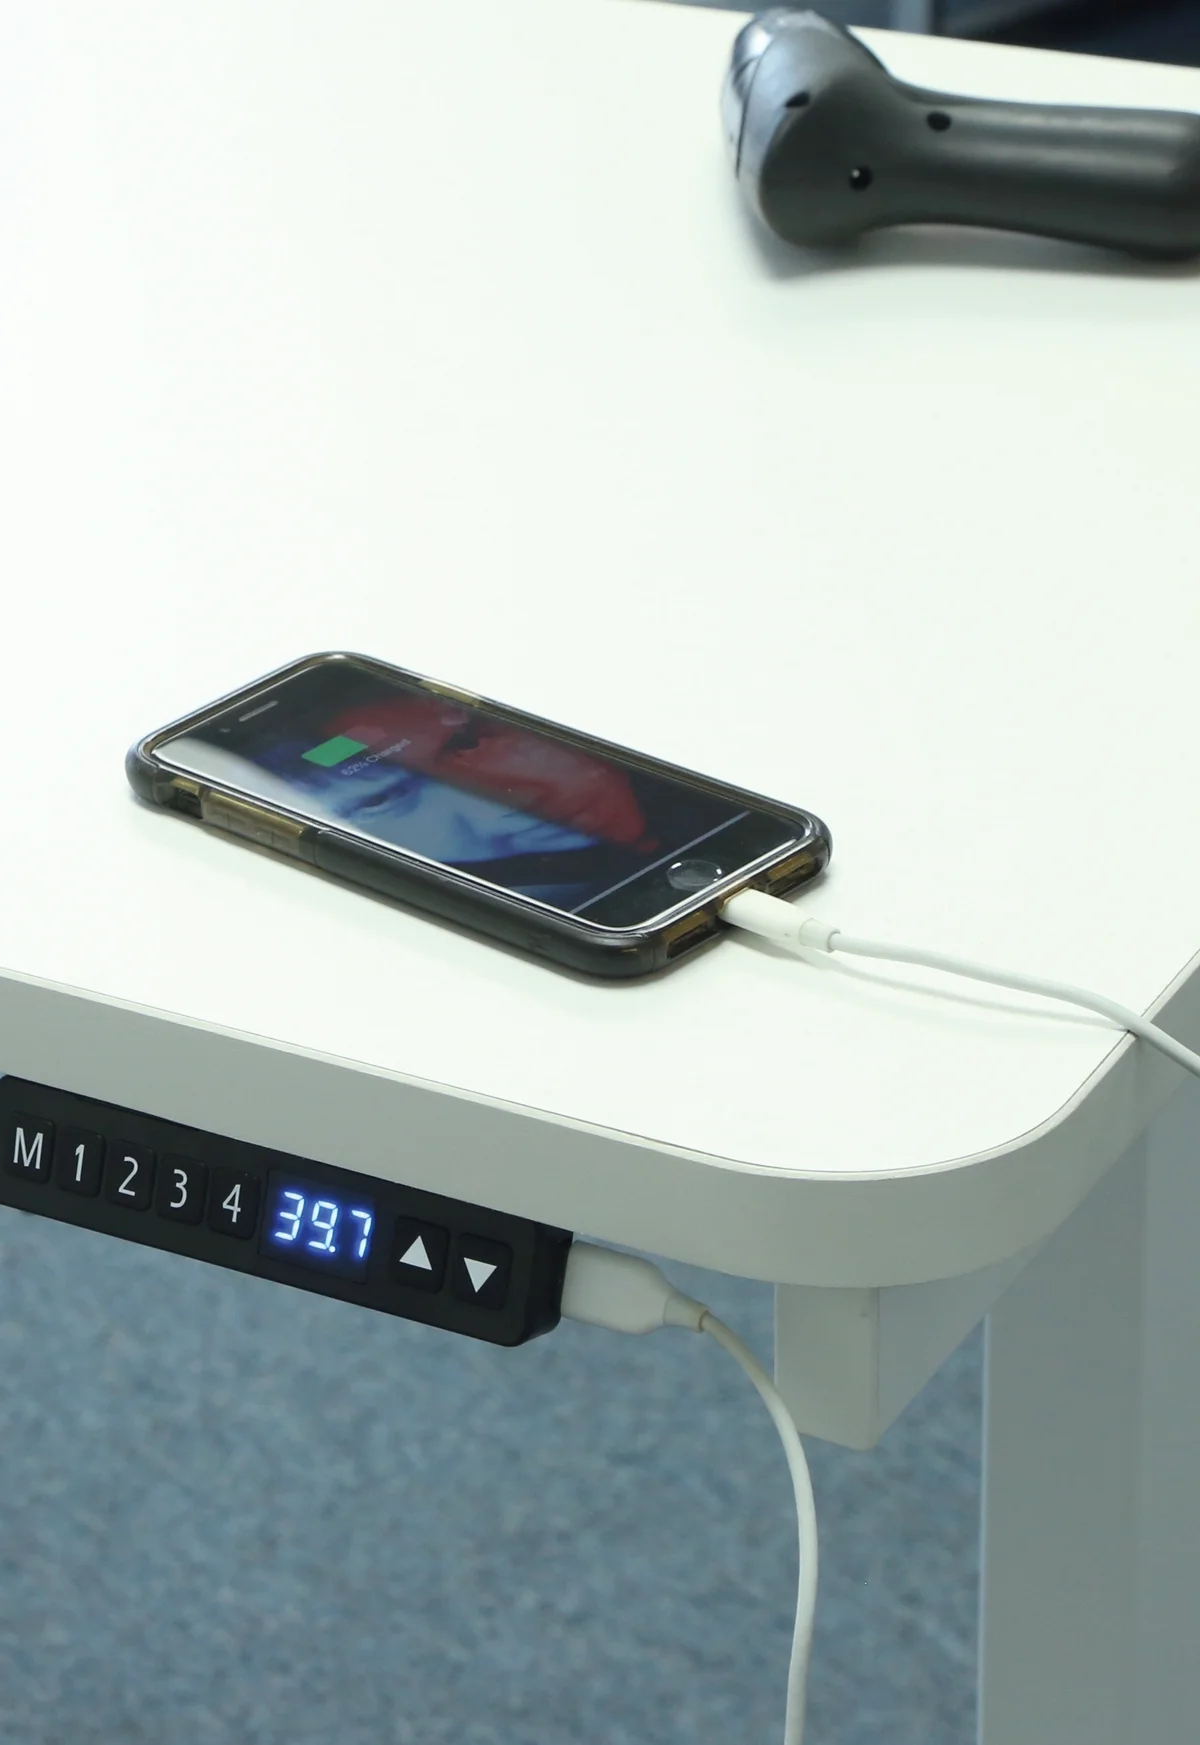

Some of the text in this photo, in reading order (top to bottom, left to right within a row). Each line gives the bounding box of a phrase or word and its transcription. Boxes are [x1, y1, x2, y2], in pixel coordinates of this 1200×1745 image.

[13, 1126, 241, 1223] M 1 2 3 4
[274, 1191, 372, 1258] 39.7
